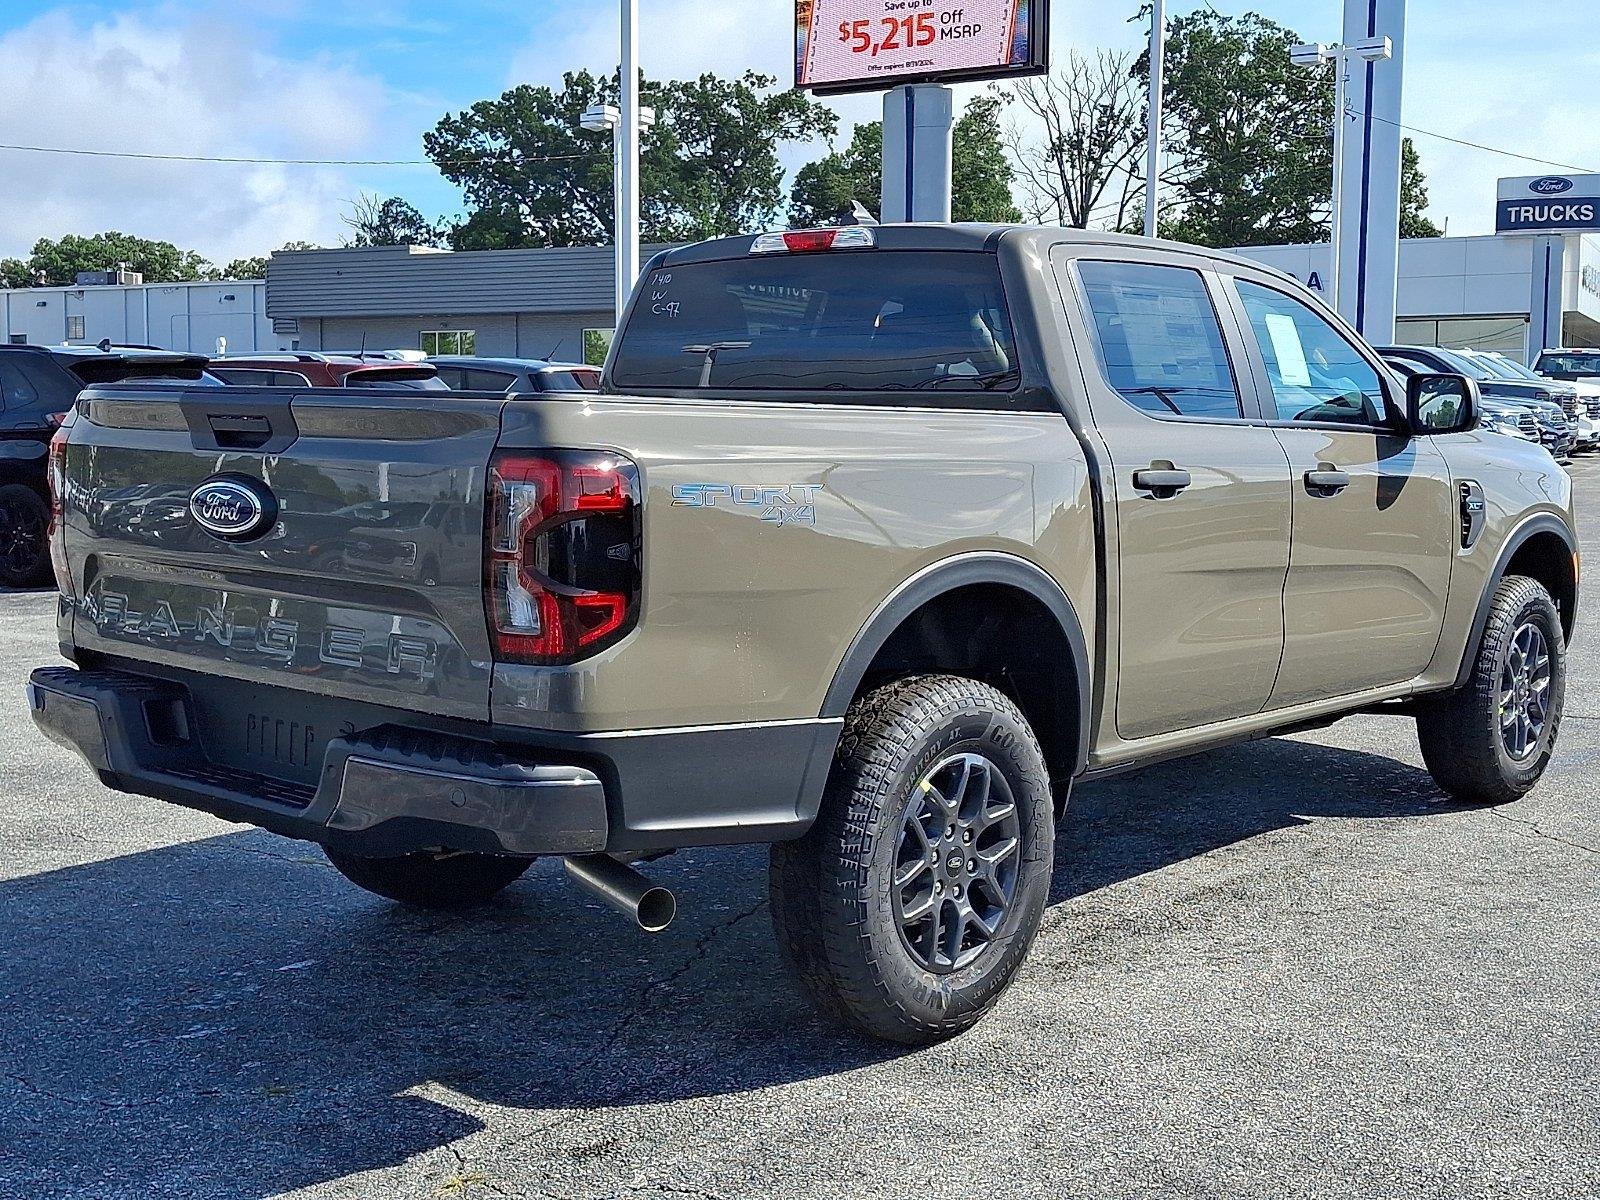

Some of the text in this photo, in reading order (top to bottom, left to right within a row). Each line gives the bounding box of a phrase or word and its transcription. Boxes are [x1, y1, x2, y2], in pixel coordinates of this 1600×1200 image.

[884, 2, 906, 11] Save
[908, 1, 920, 9] up
[838, 9, 964, 56] $5,215 Off
[940, 24, 982, 40] MSRP
[1507, 204, 1594, 222] TRUCKS
[671, 484, 825, 506] SPORT
[99, 589, 439, 679] RANGER
